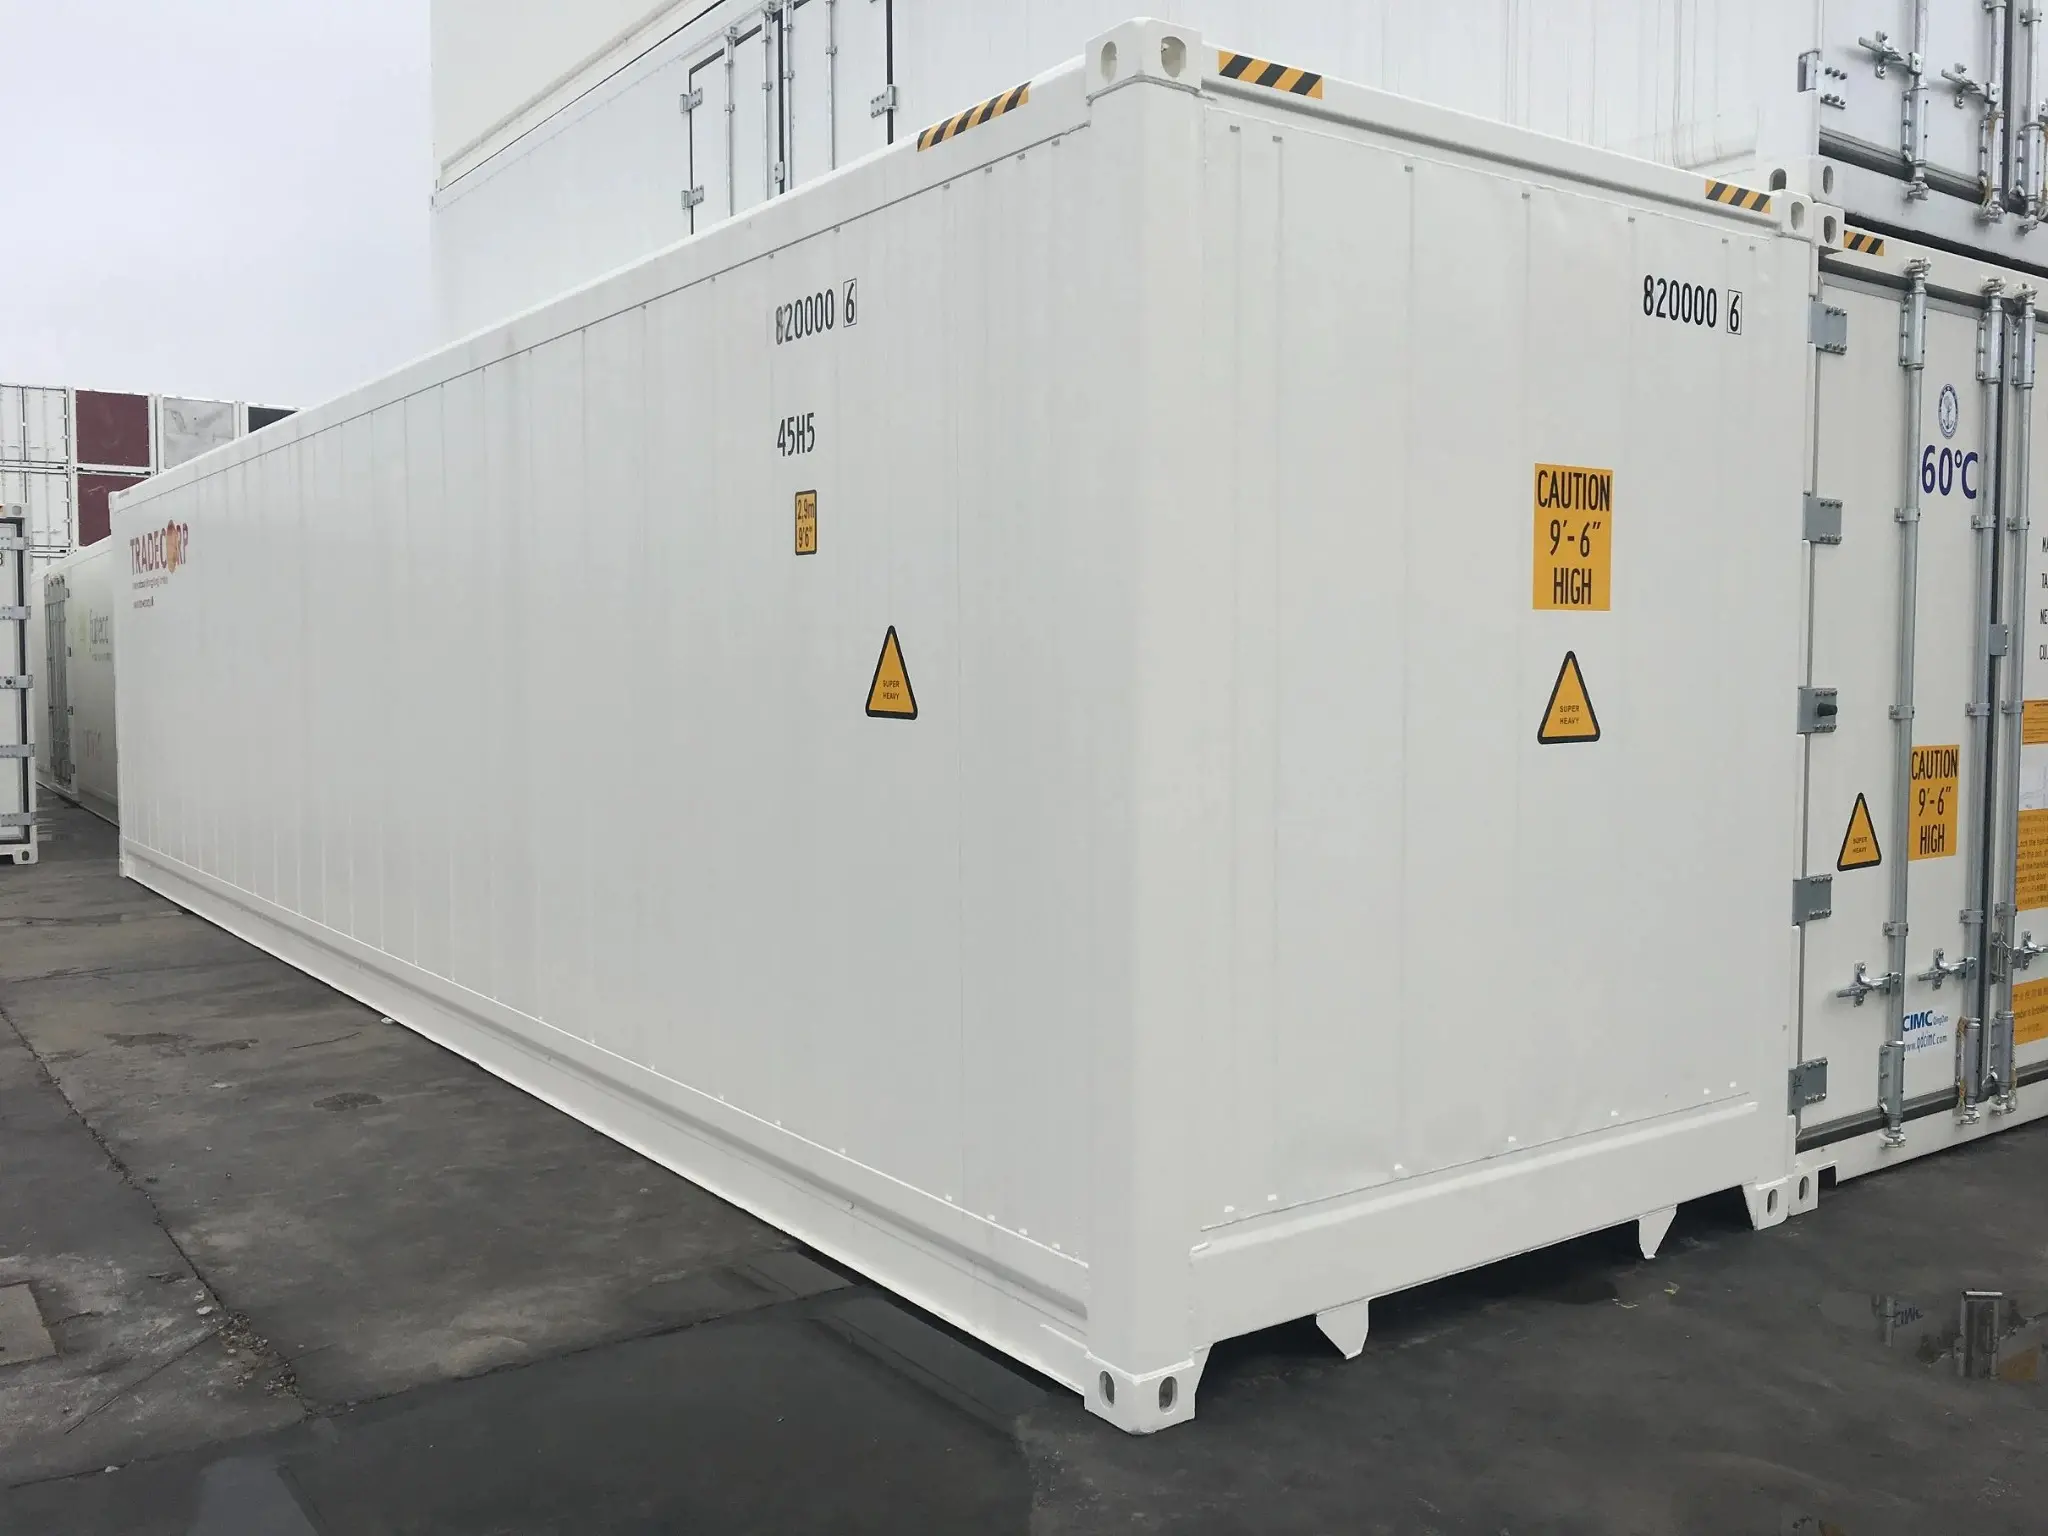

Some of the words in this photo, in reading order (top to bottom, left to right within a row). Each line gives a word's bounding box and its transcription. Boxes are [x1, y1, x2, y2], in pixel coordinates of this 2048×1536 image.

[775, 288, 834, 345] 820000
[844, 280, 856, 325] 6
[1643, 274, 1717, 328] 820000
[1728, 291, 1741, 333] 6
[777, 412, 815, 457] 45H5
[1921, 445, 1978, 499] 60°C
[1537, 470, 1610, 511] CAUTION
[1553, 568, 1592, 604] HIGH
[883, 680, 900, 688] SUPER
[883, 692, 900, 700] HEAVY
[1560, 705, 1579, 713] SUPER
[1560, 717, 1580, 725] HEAVY
[1912, 749, 1958, 780] CAUTION
[1920, 824, 1945, 855] HIGH
[1903, 1010, 1933, 1032] CIMC
